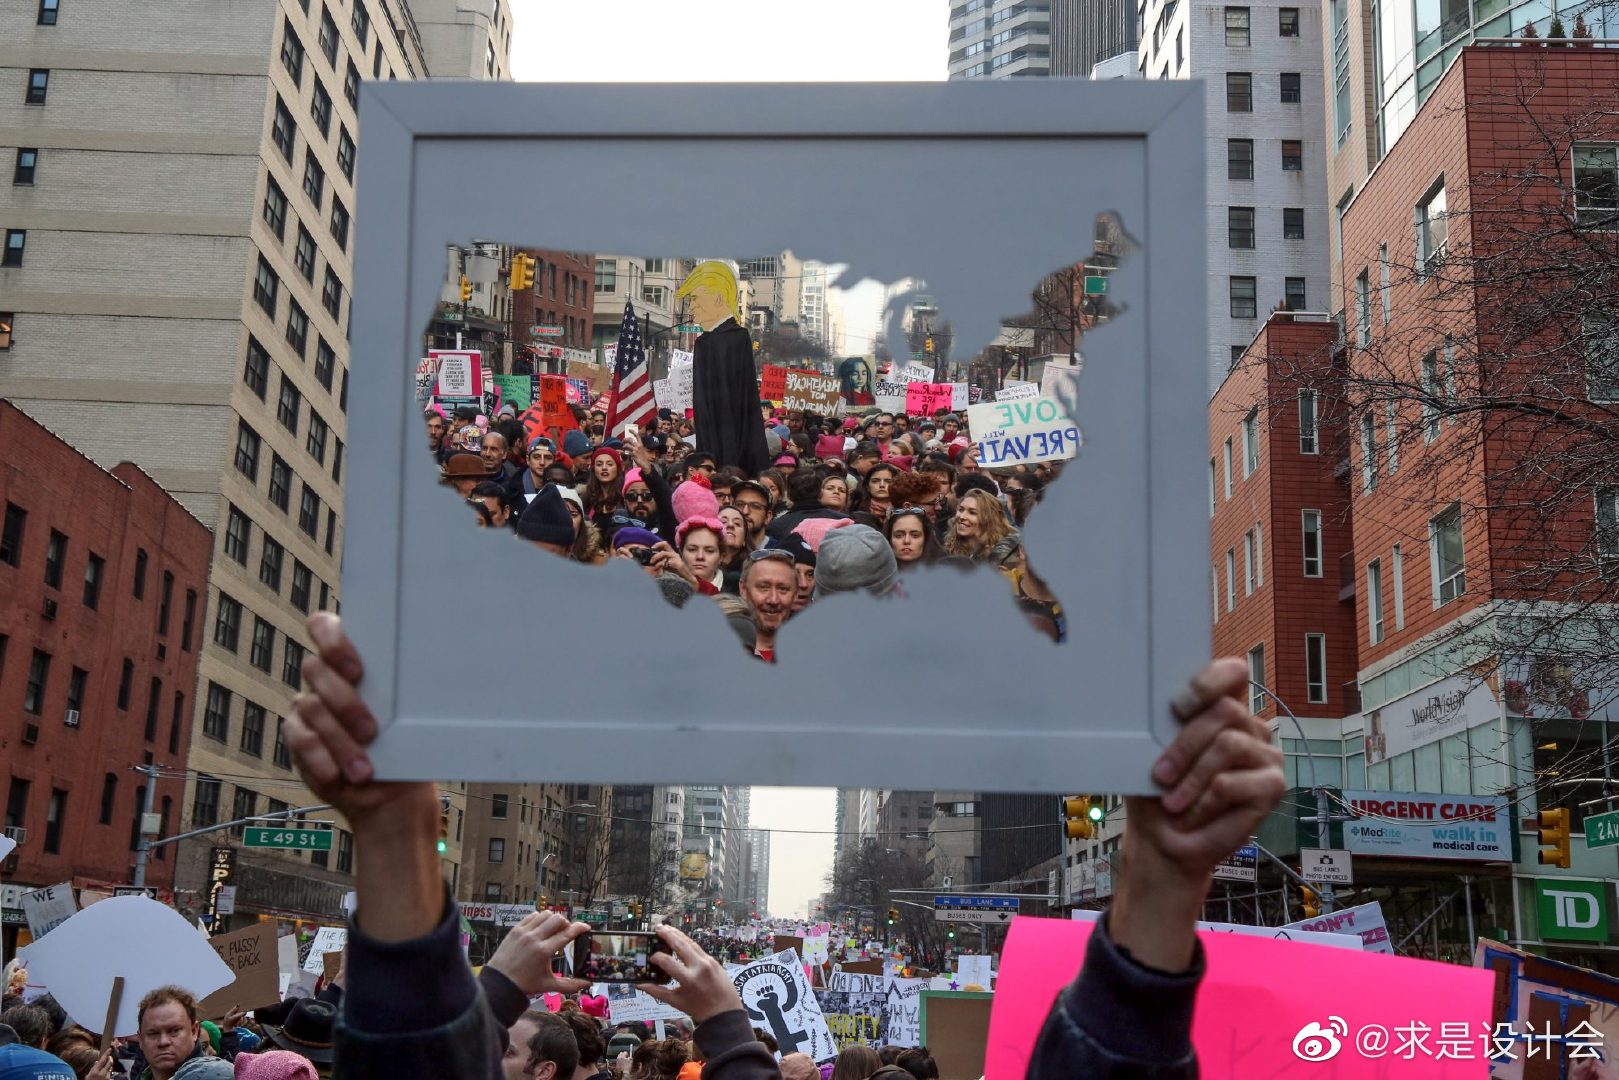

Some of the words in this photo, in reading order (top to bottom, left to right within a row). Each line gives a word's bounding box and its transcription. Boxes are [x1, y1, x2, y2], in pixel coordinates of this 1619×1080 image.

[1351, 799, 1436, 820] URGENT
[1440, 803, 1496, 822] CARE
[260, 831, 269, 842] E
[273, 833, 294, 844] 49
[299, 833, 316, 846] St
[1361, 827, 1401, 838] MedRite
[1433, 827, 1475, 841] walk
[1480, 827, 1496, 842] in
[1598, 822, 1605, 840] 2
[1433, 841, 1474, 851] medical
[1476, 844, 1499, 852] care
[32, 888, 55, 904] WE
[976, 898, 993, 906] LANE
[463, 904, 492, 918] iness
[1542, 889, 1600, 929] TD
[1301, 912, 1355, 932] DON'T
[320, 930, 337, 941] THE
[229, 936, 260, 957] PUSSY
[238, 952, 262, 970] BACK
[830, 1013, 881, 1039] ARITY
